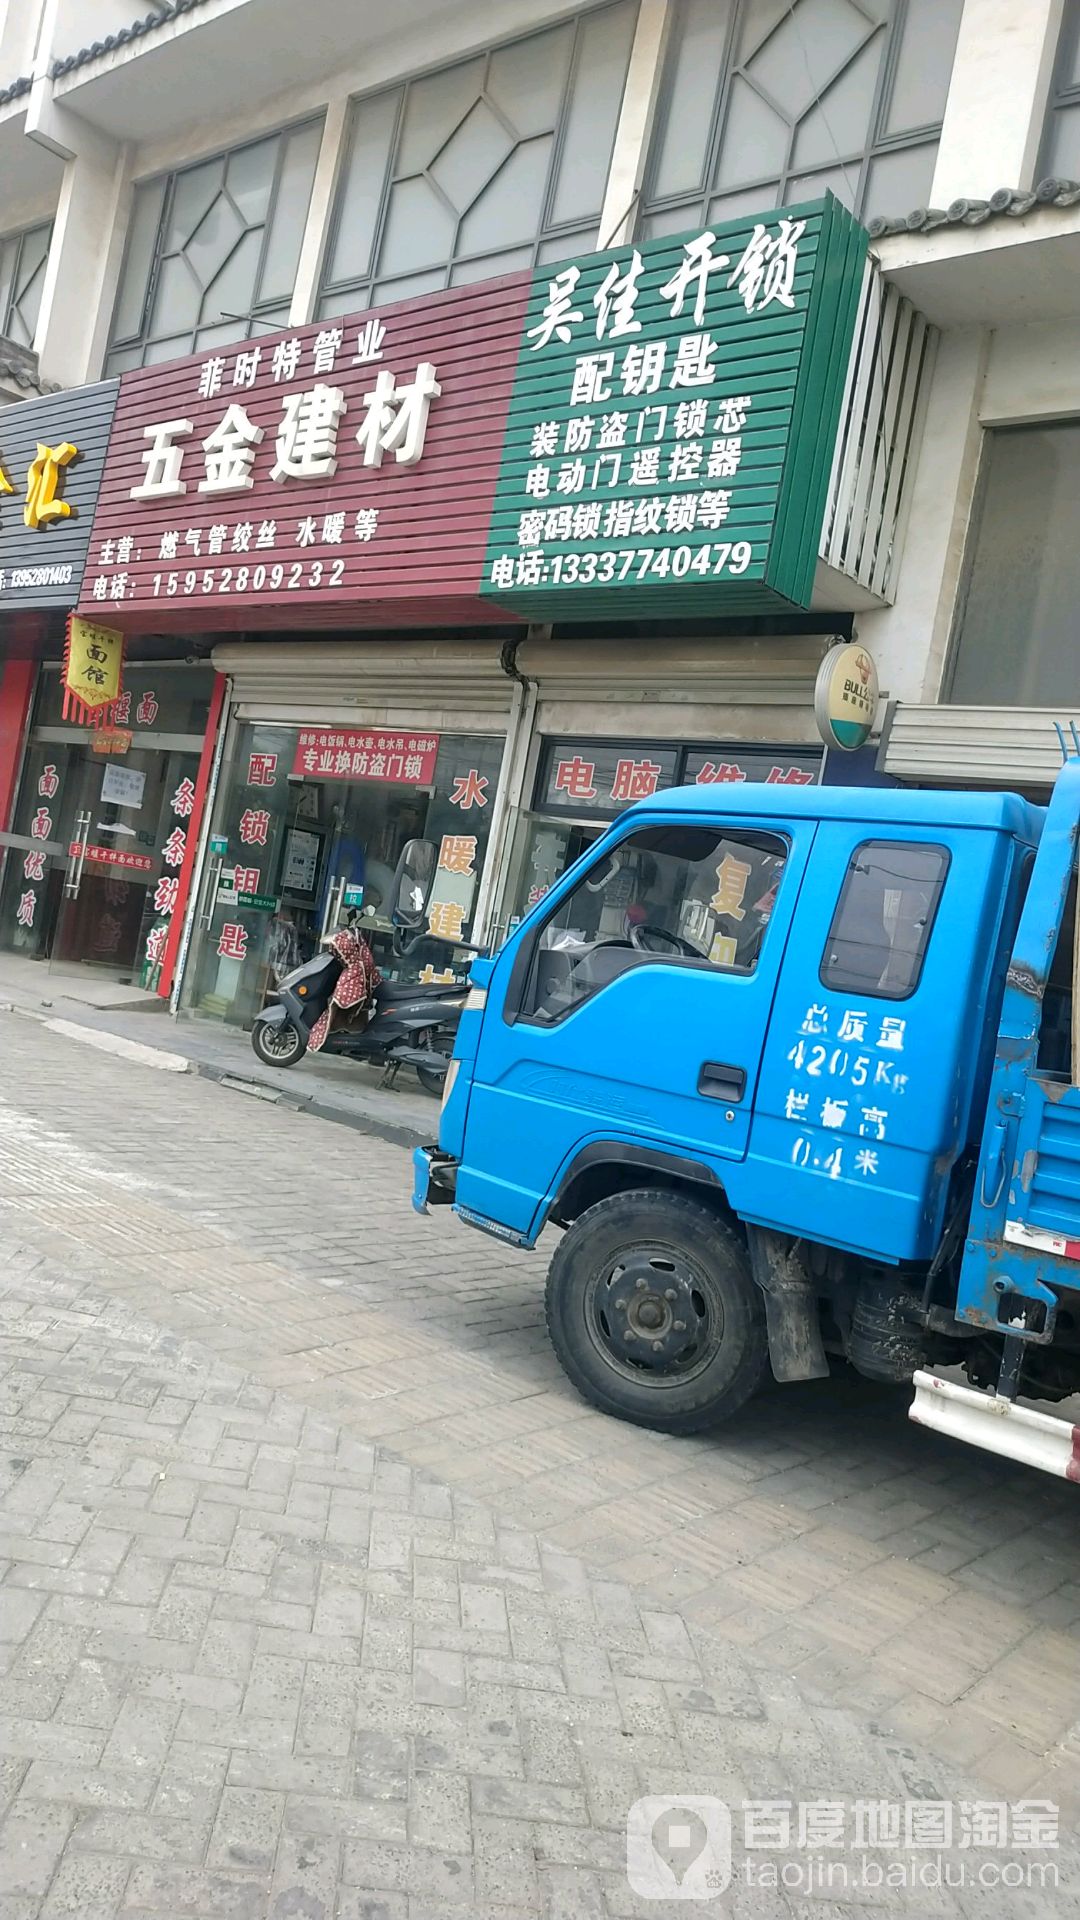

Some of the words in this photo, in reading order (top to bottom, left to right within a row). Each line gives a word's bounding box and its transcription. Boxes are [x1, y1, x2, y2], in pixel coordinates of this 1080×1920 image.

[527, 215, 806, 351] 吴佳开锁
[198, 319, 387, 399] 菲时特管业
[569, 334, 719, 406] 配钥匙
[129, 362, 442, 501] 五金建材
[529, 397, 751, 458] 装防盗门锁芯
[0, 442, 78, 529] 汇
[525, 437, 742, 498] 电动门遥控器
[517, 490, 732, 548] 密码锁指纹锁等
[490, 542, 752, 590] 电话:13337740479
[81, 644, 109, 685] 面馆
[302, 748, 424, 780] 专业换防盗门锁
[217, 752, 277, 960] 配锁钥匙
[800, 1002, 907, 1051] 总质量
[783, 1087, 889, 1141] 栏板高
